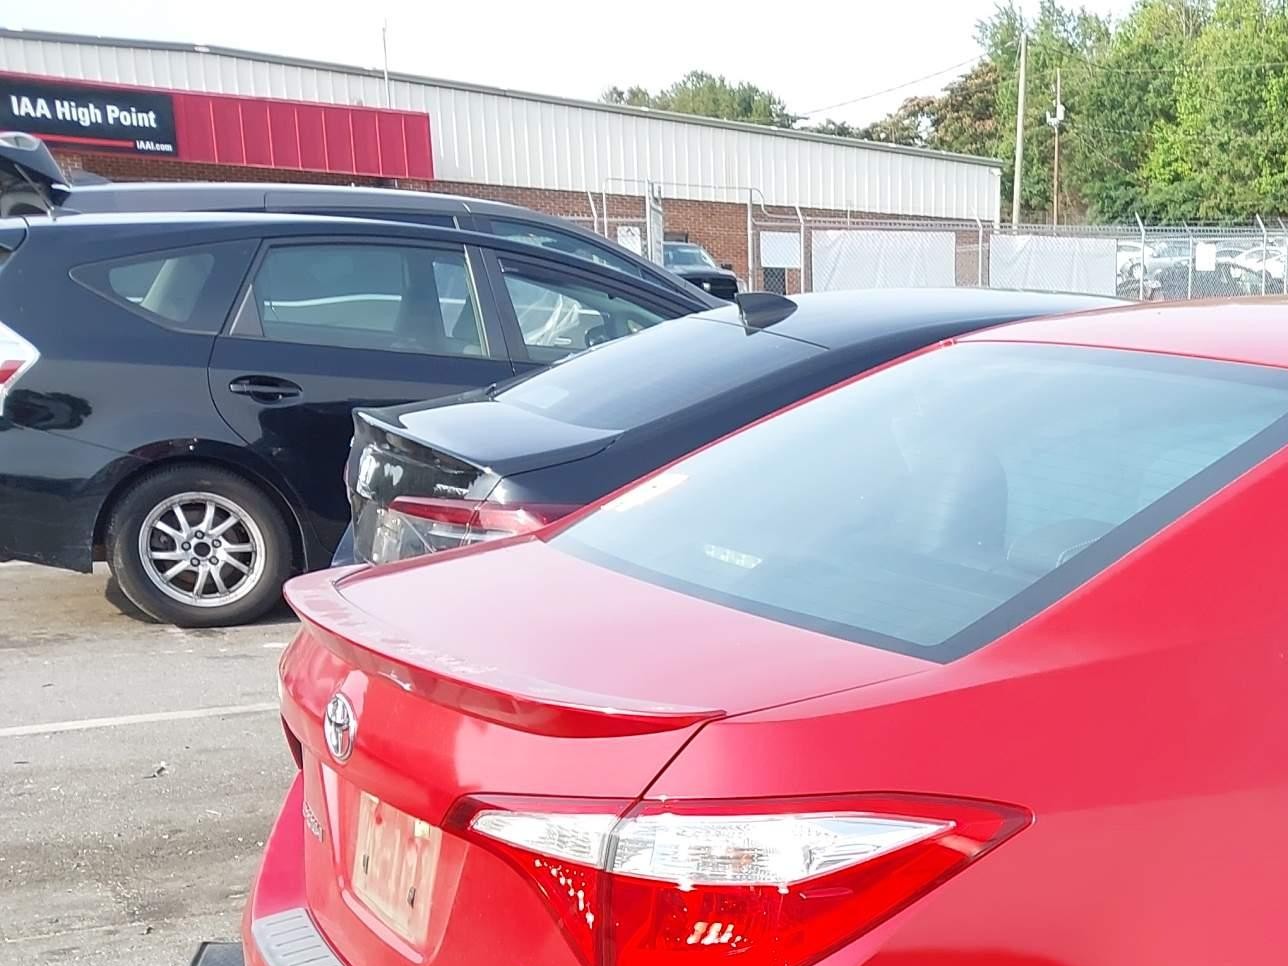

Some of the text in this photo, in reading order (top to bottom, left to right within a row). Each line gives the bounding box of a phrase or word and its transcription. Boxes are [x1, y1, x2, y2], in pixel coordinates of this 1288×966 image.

[10, 94, 157, 128] IAA High Point
[135, 140, 173, 152] IAAI.com
